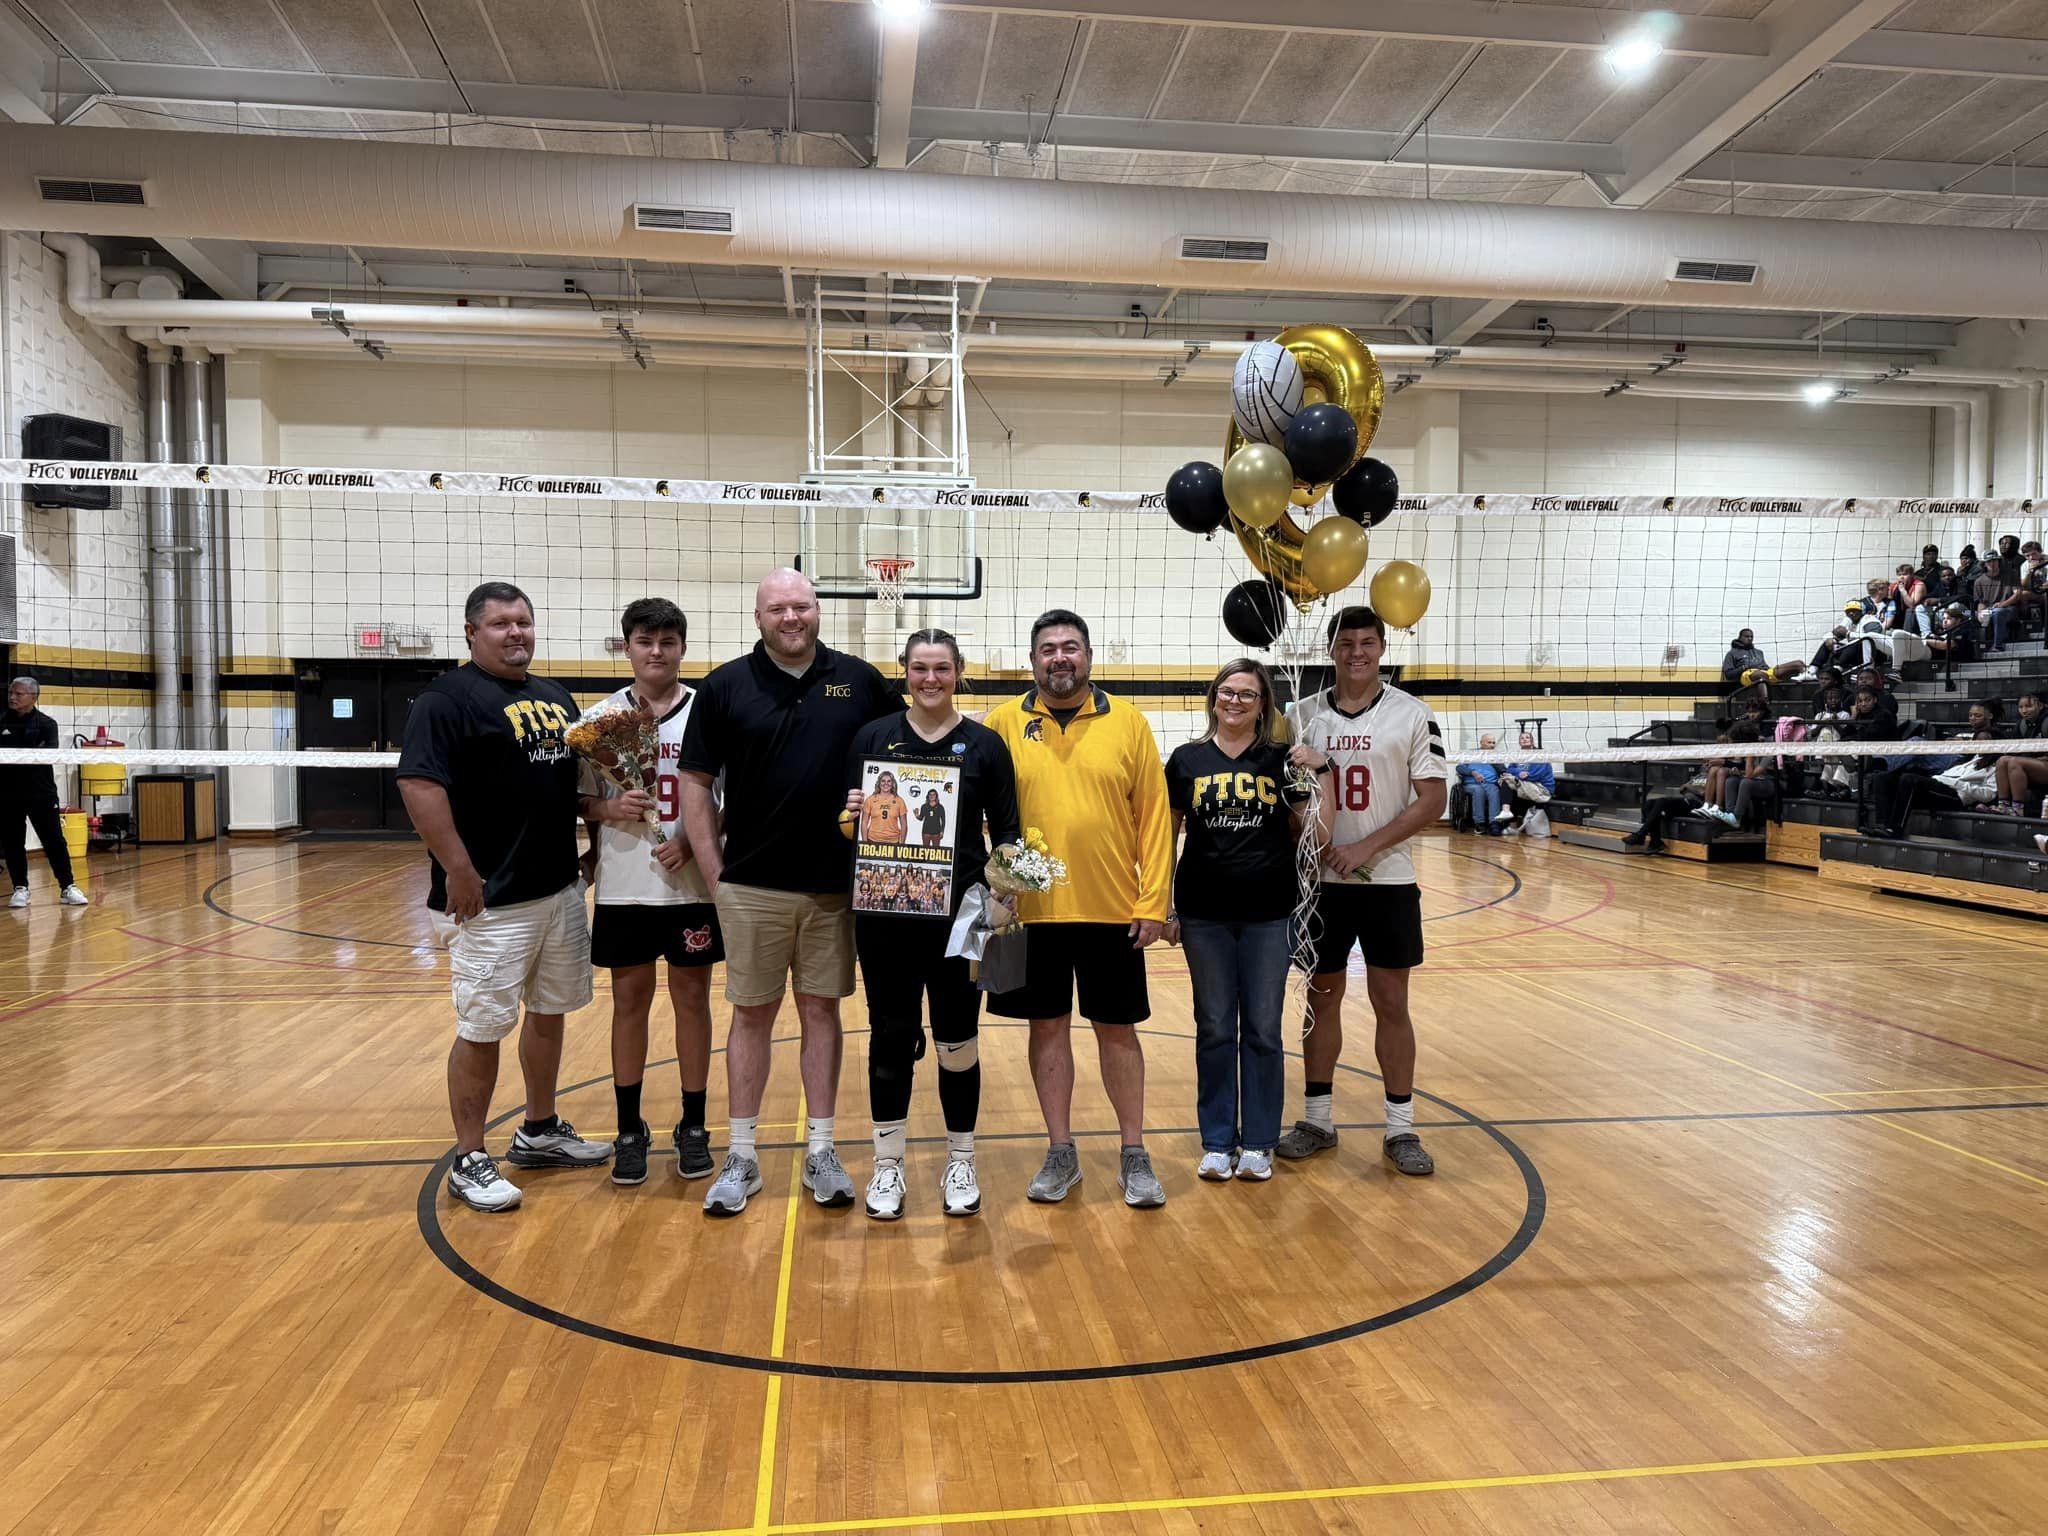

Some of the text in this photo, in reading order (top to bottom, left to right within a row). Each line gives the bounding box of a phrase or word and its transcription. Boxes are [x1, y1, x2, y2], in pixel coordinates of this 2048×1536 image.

[26, 462, 139, 481] FTCC VOLLEYBALL
[266, 468, 375, 487] FTCC VOLLEYBALL
[497, 475, 603, 494] FTCC VOLLEYBALL
[722, 483, 822, 501] FTCC VOLLEYBALL
[935, 489, 1030, 507] FTCC VOLLEYBALL
[1393, 499, 1428, 511] EYBALL
[1531, 495, 1619, 511] FTCC VOLLEYBALL
[1718, 497, 1802, 512] FTCC VOLLEYBALL
[1897, 498, 1979, 513] FTCC VOLLEYBALL
[825, 684, 852, 697] FTCC
[503, 699, 569, 740] FTCC
[1326, 735, 1372, 751] LIONS
[528, 746, 571, 765] Volleyball
[867, 765, 880, 775] #9
[1192, 772, 1278, 808] FTCC
[1333, 765, 1370, 812] 18
[1205, 815, 1263, 832] Volleyball
[858, 844, 952, 862] TROJAN VOLLEYBALL
